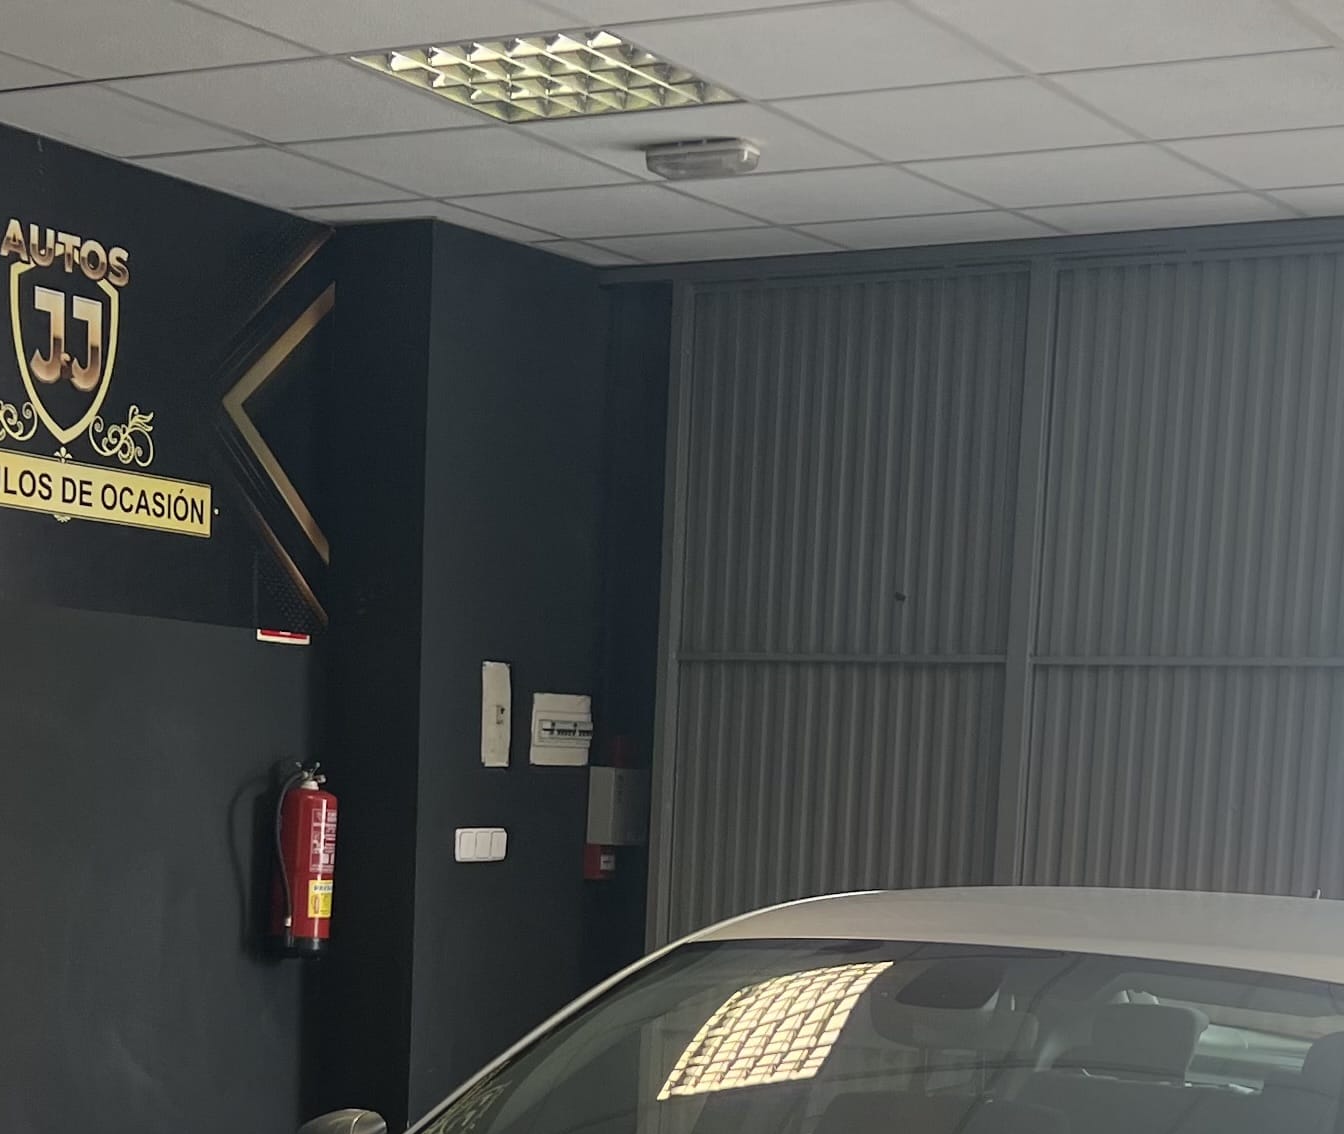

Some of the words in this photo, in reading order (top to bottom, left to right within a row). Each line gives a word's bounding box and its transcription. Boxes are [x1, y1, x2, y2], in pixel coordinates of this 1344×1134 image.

[0, 218, 130, 288] AUTOS
[61, 477, 94, 507] DE
[101, 485, 205, 524] OCASIÓN
